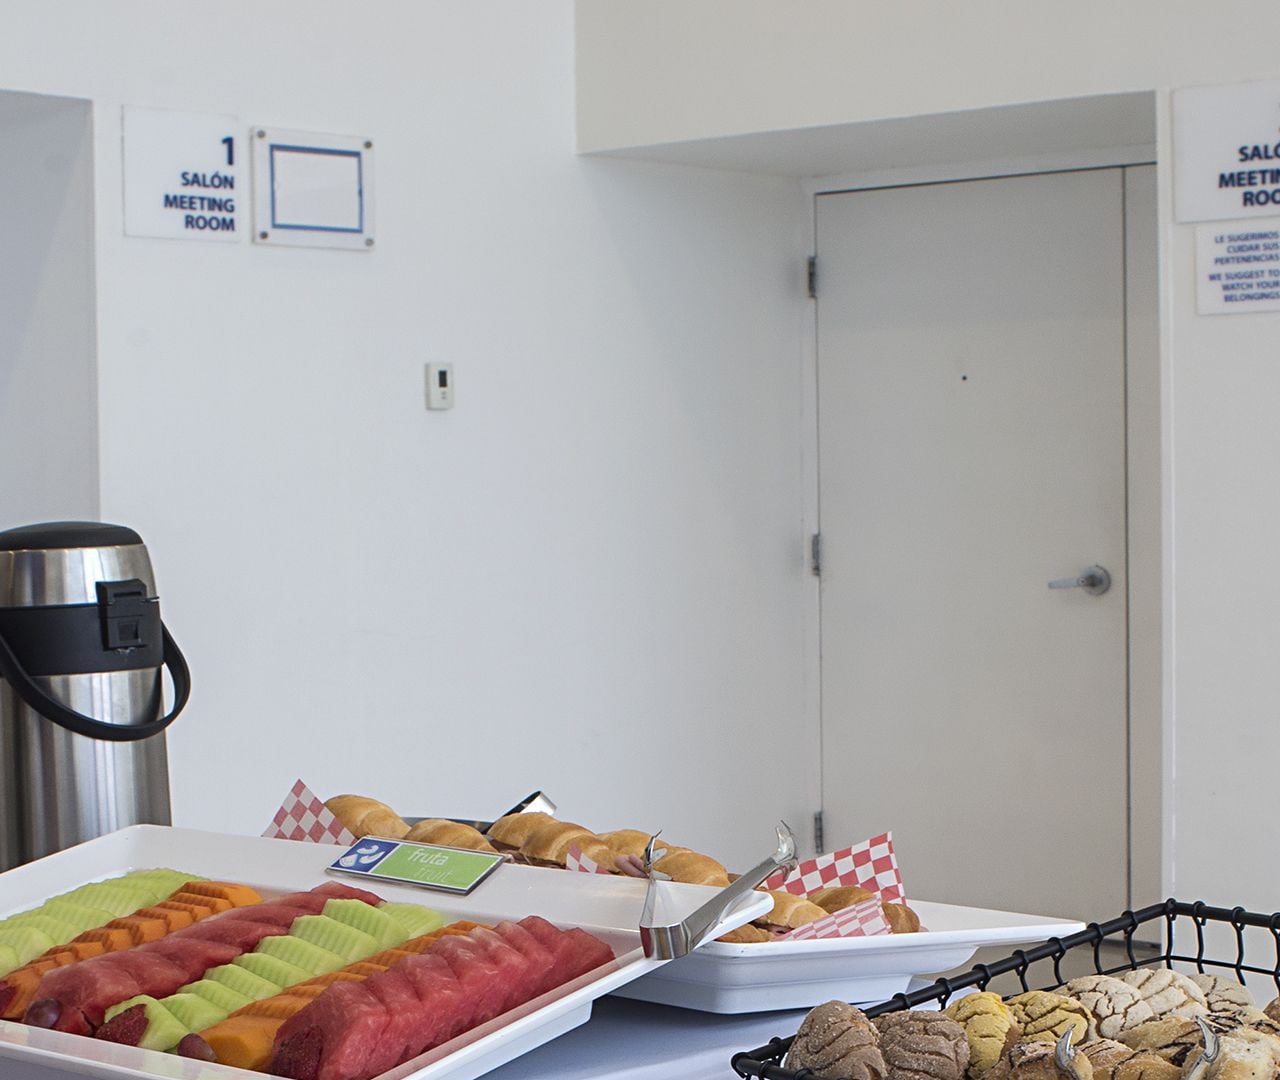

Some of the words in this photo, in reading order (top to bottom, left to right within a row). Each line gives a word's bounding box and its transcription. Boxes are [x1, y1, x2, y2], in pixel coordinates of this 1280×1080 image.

[221, 136, 235, 166] 1
[181, 171, 235, 189] SALÓN
[164, 194, 235, 213] MEETING
[185, 215, 236, 231] ROOM
[1268, 268, 1280, 277] TO
[1256, 279, 1280, 289] YOUR
[408, 848, 449, 866] fruta
[413, 866, 454, 883] fruit
